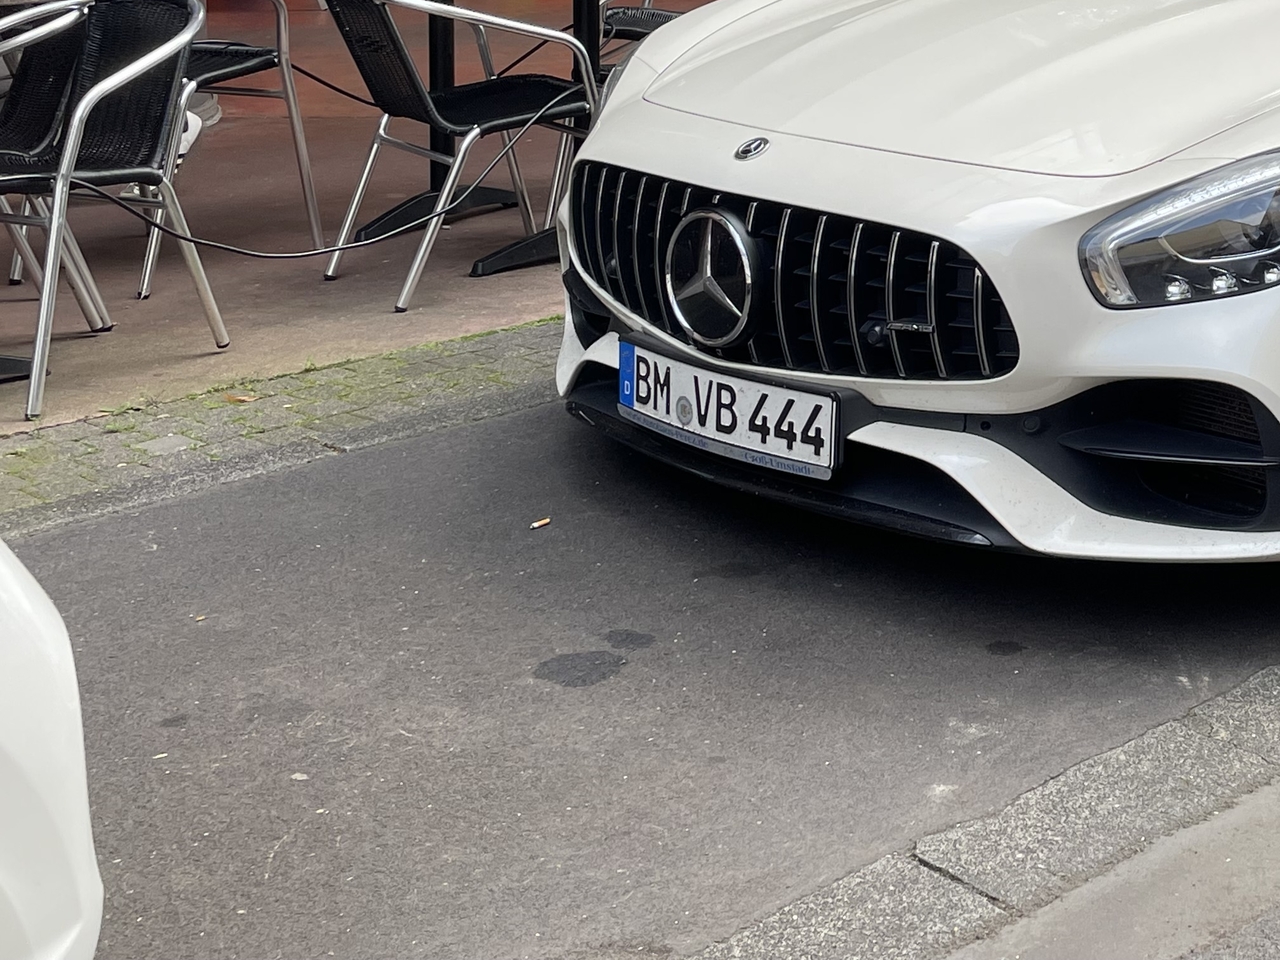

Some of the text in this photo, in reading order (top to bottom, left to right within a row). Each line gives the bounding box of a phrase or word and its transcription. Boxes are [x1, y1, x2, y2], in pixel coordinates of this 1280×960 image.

[624, 381, 631, 395] D
[635, 354, 825, 457] BM VB 444
